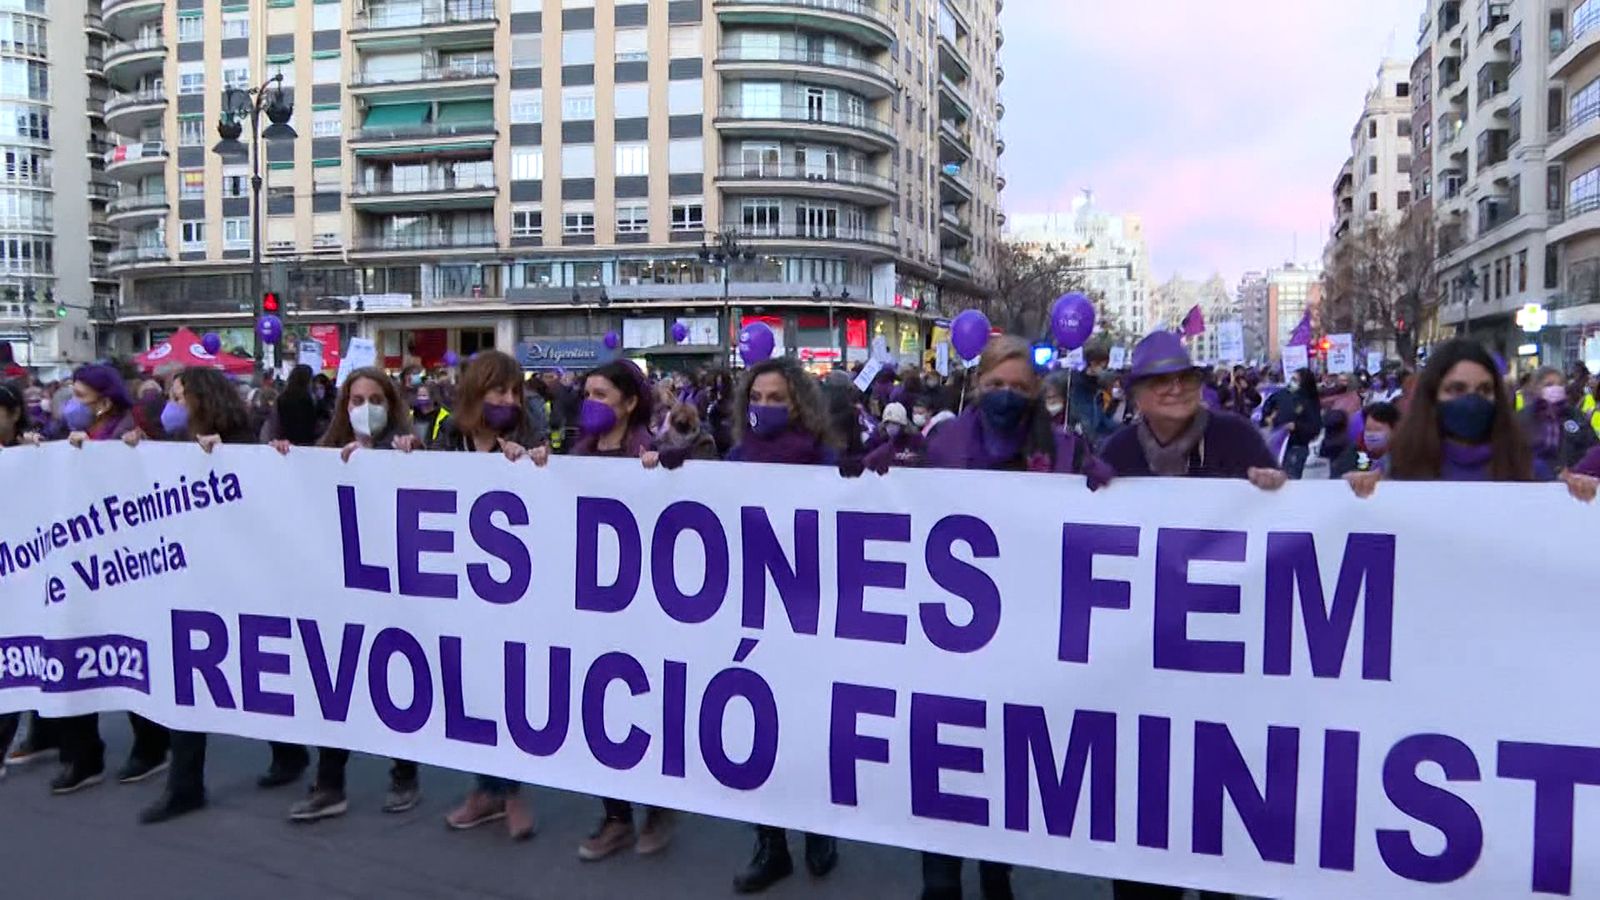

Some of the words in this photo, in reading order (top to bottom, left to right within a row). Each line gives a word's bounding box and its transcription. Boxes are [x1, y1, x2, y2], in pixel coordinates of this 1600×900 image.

[104, 470, 243, 532] Feminista
[44, 573, 66, 607] e
[71, 536, 188, 592] València
[336, 485, 533, 605] LES
[574, 496, 1002, 654] DONES
[1057, 523, 1397, 682] FEM
[75, 644, 145, 681] 2022
[170, 609, 780, 792] REVOLUCIÓ
[828, 682, 1600, 897] FEMINIST
